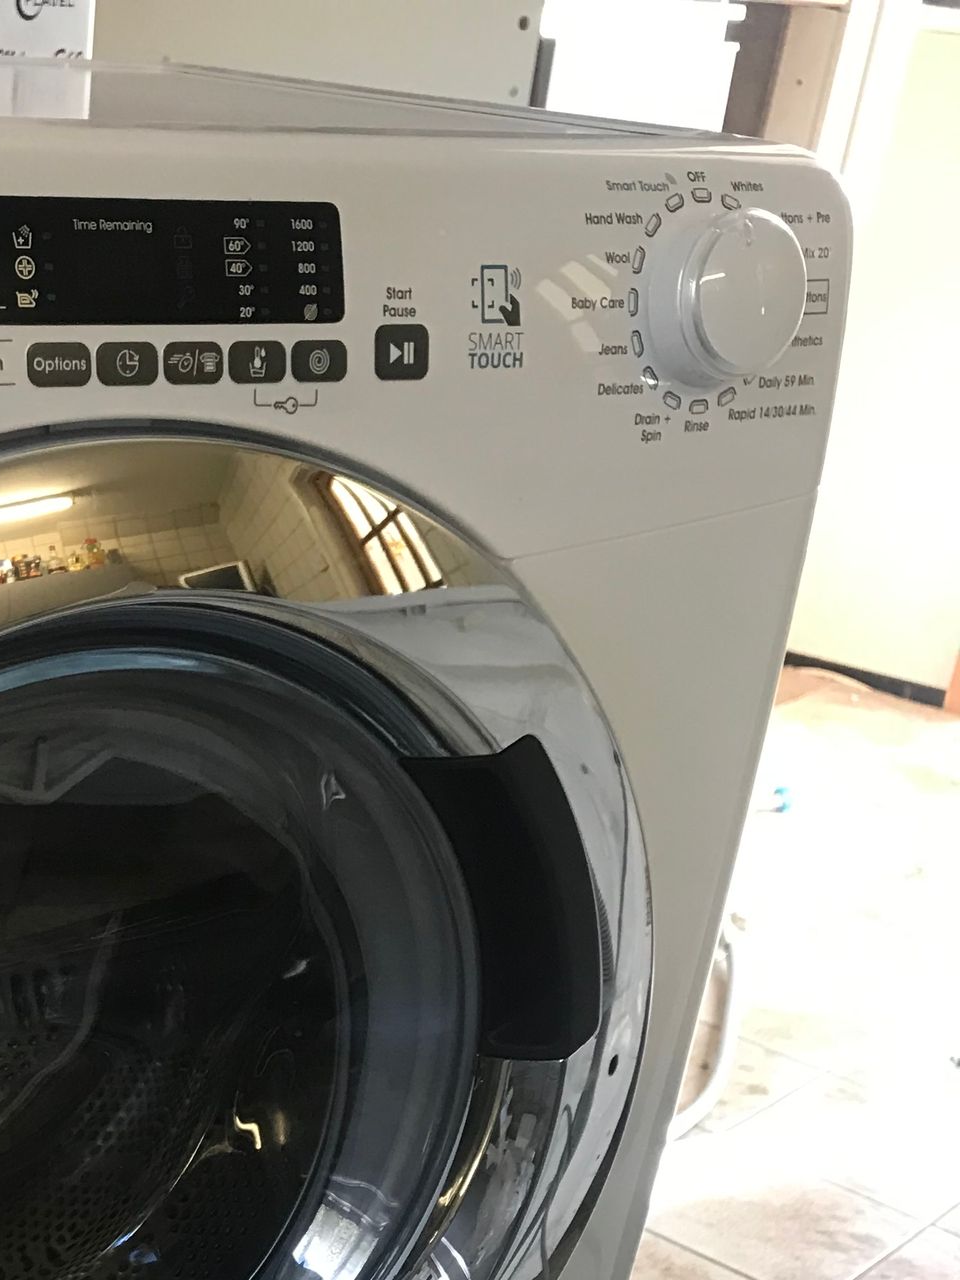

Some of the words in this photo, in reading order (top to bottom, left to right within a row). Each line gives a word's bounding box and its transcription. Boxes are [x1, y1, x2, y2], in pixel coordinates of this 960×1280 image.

[605, 180, 637, 191] Smart
[640, 180, 670, 192] Touch
[730, 181, 764, 192] Whites
[585, 212, 613, 225] Hand
[615, 213, 643, 225] Wash
[816, 211, 831, 224] Pre
[73, 219, 97, 230] Time
[99, 219, 153, 233] Remaining
[290, 219, 313, 230] 1600
[291, 241, 315, 252] 1200
[605, 252, 631, 264] Wool
[298, 263, 316, 274] 800
[299, 285, 317, 295] 400
[386, 287, 413, 300] Start
[571, 297, 597, 311] Baby
[600, 296, 625, 309] Care
[383, 304, 416, 318] Pause
[468, 332, 524, 351] SMART
[598, 343, 628, 355] Jeans
[33, 356, 87, 375] Options
[468, 352, 524, 369] TOUCH
[758, 376, 782, 389] Daily
[784, 375, 796, 387] 59
[597, 383, 644, 395] Delicates
[634, 413, 660, 426] Drain
[728, 408, 756, 422] Rapid
[684, 420, 709, 432] Rinse
[640, 429, 661, 443] Spin
